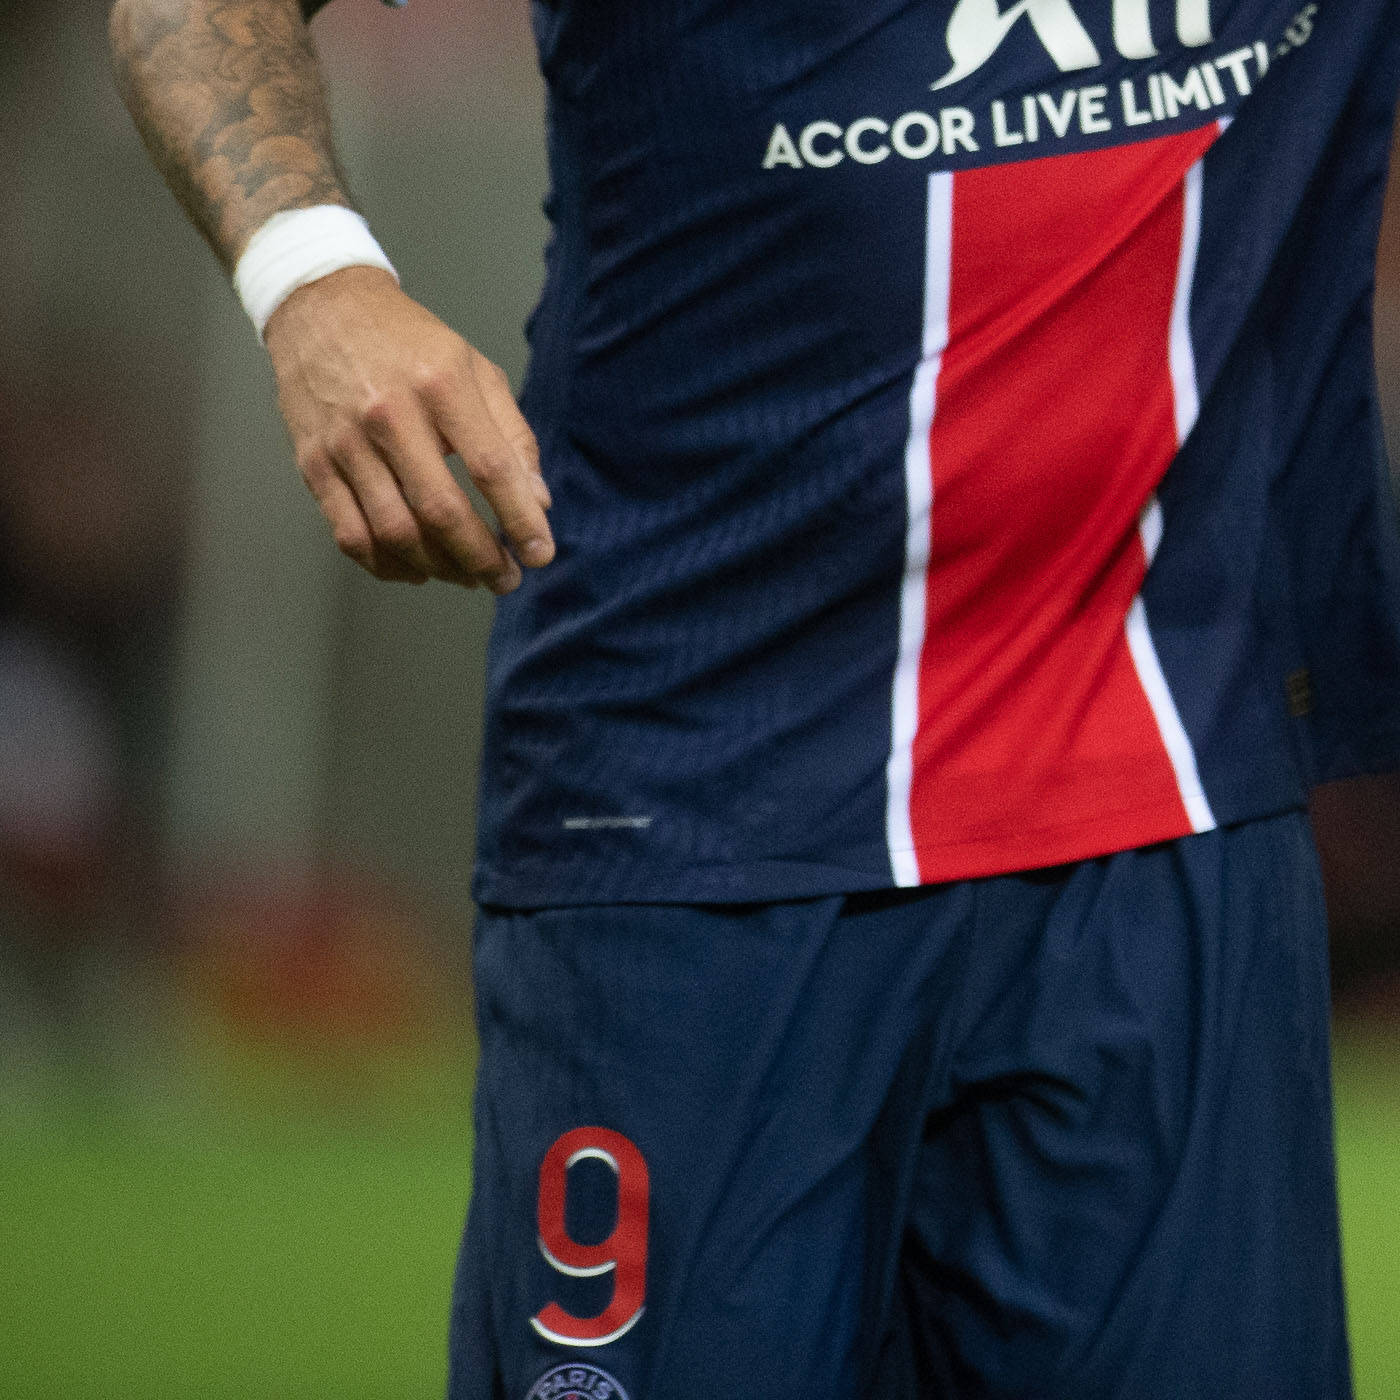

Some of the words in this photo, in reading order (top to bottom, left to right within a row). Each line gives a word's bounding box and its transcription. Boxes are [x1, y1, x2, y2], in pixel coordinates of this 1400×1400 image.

[761, 106, 980, 169] ACCOR
[992, 85, 1112, 148] LIVE
[529, 1125, 650, 1347] 9
